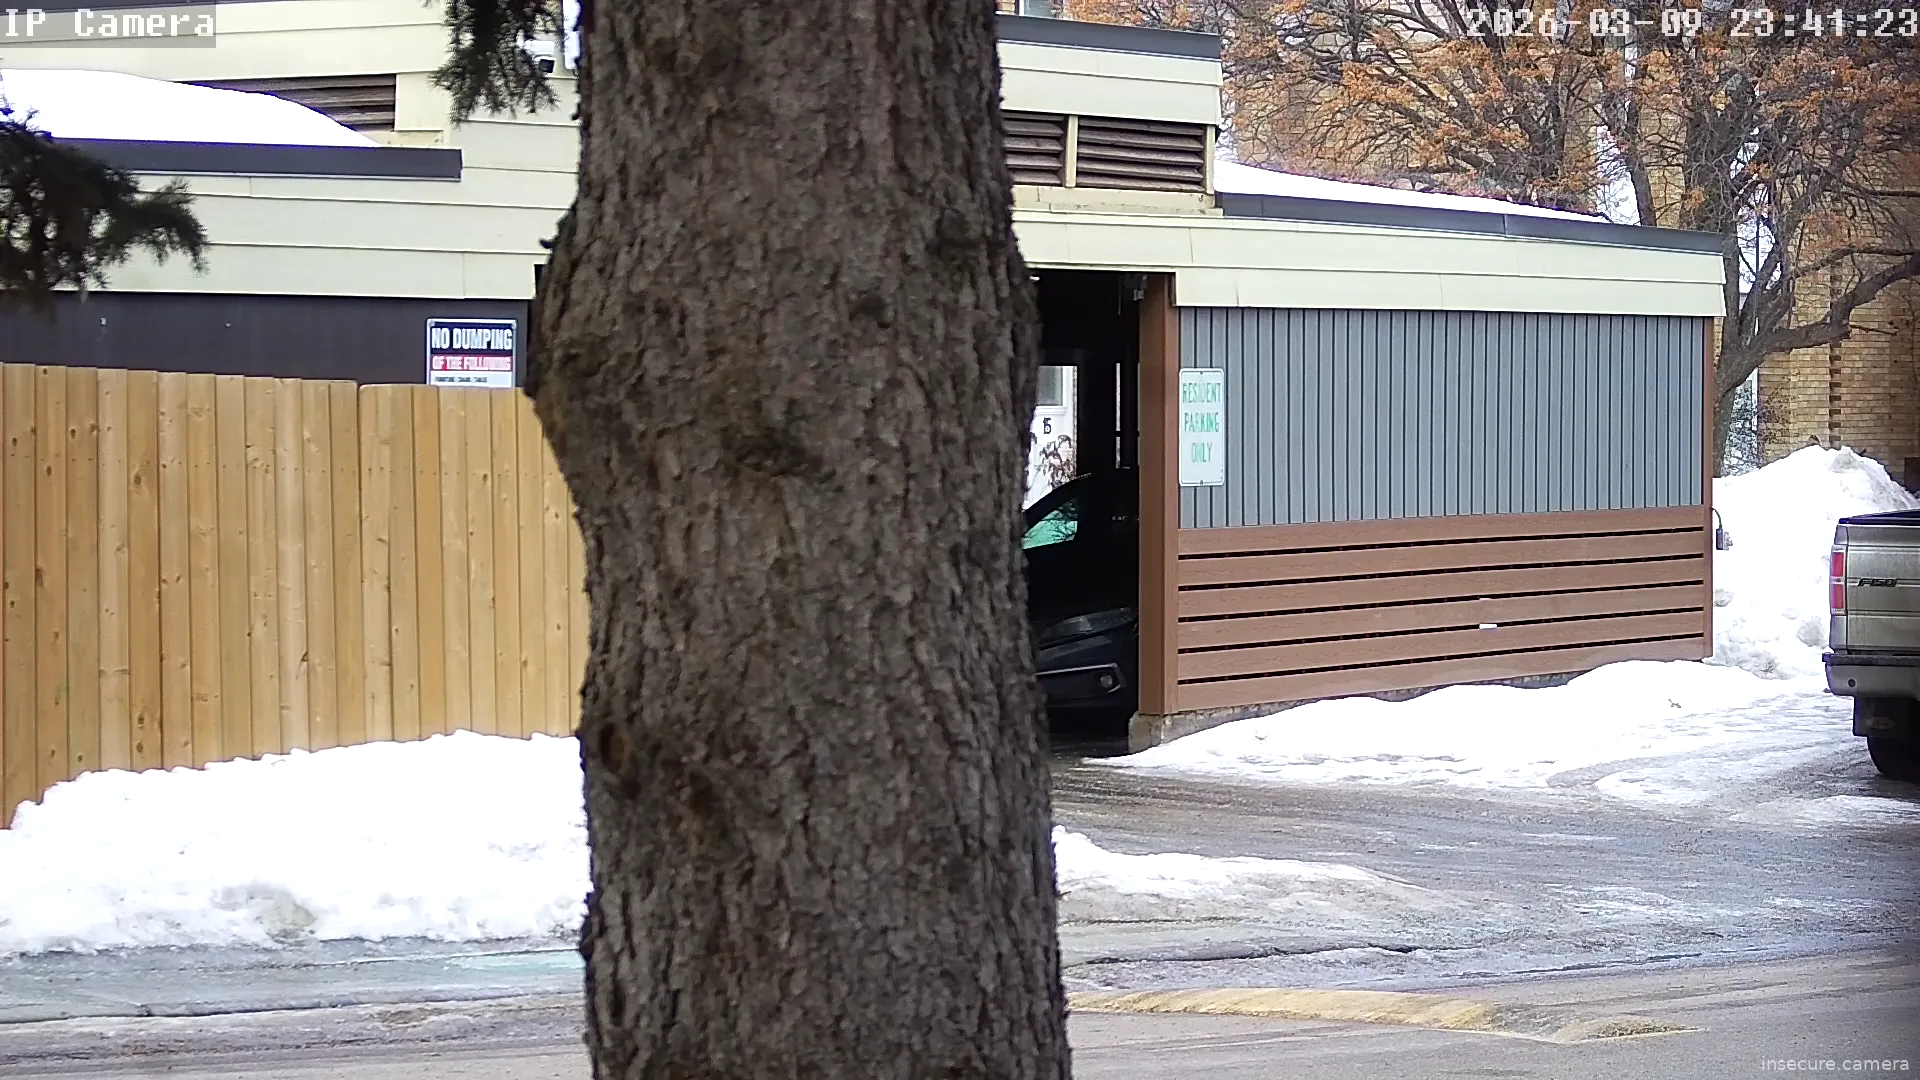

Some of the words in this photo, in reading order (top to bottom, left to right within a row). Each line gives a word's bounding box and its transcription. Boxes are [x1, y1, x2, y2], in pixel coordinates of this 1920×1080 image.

[432, 328, 450, 348] NO
[453, 328, 512, 350] DUMPING
[1183, 383, 1221, 403] RESIDENT
[1185, 412, 1219, 432] PARKING
[1192, 442, 1212, 462] ONLY
